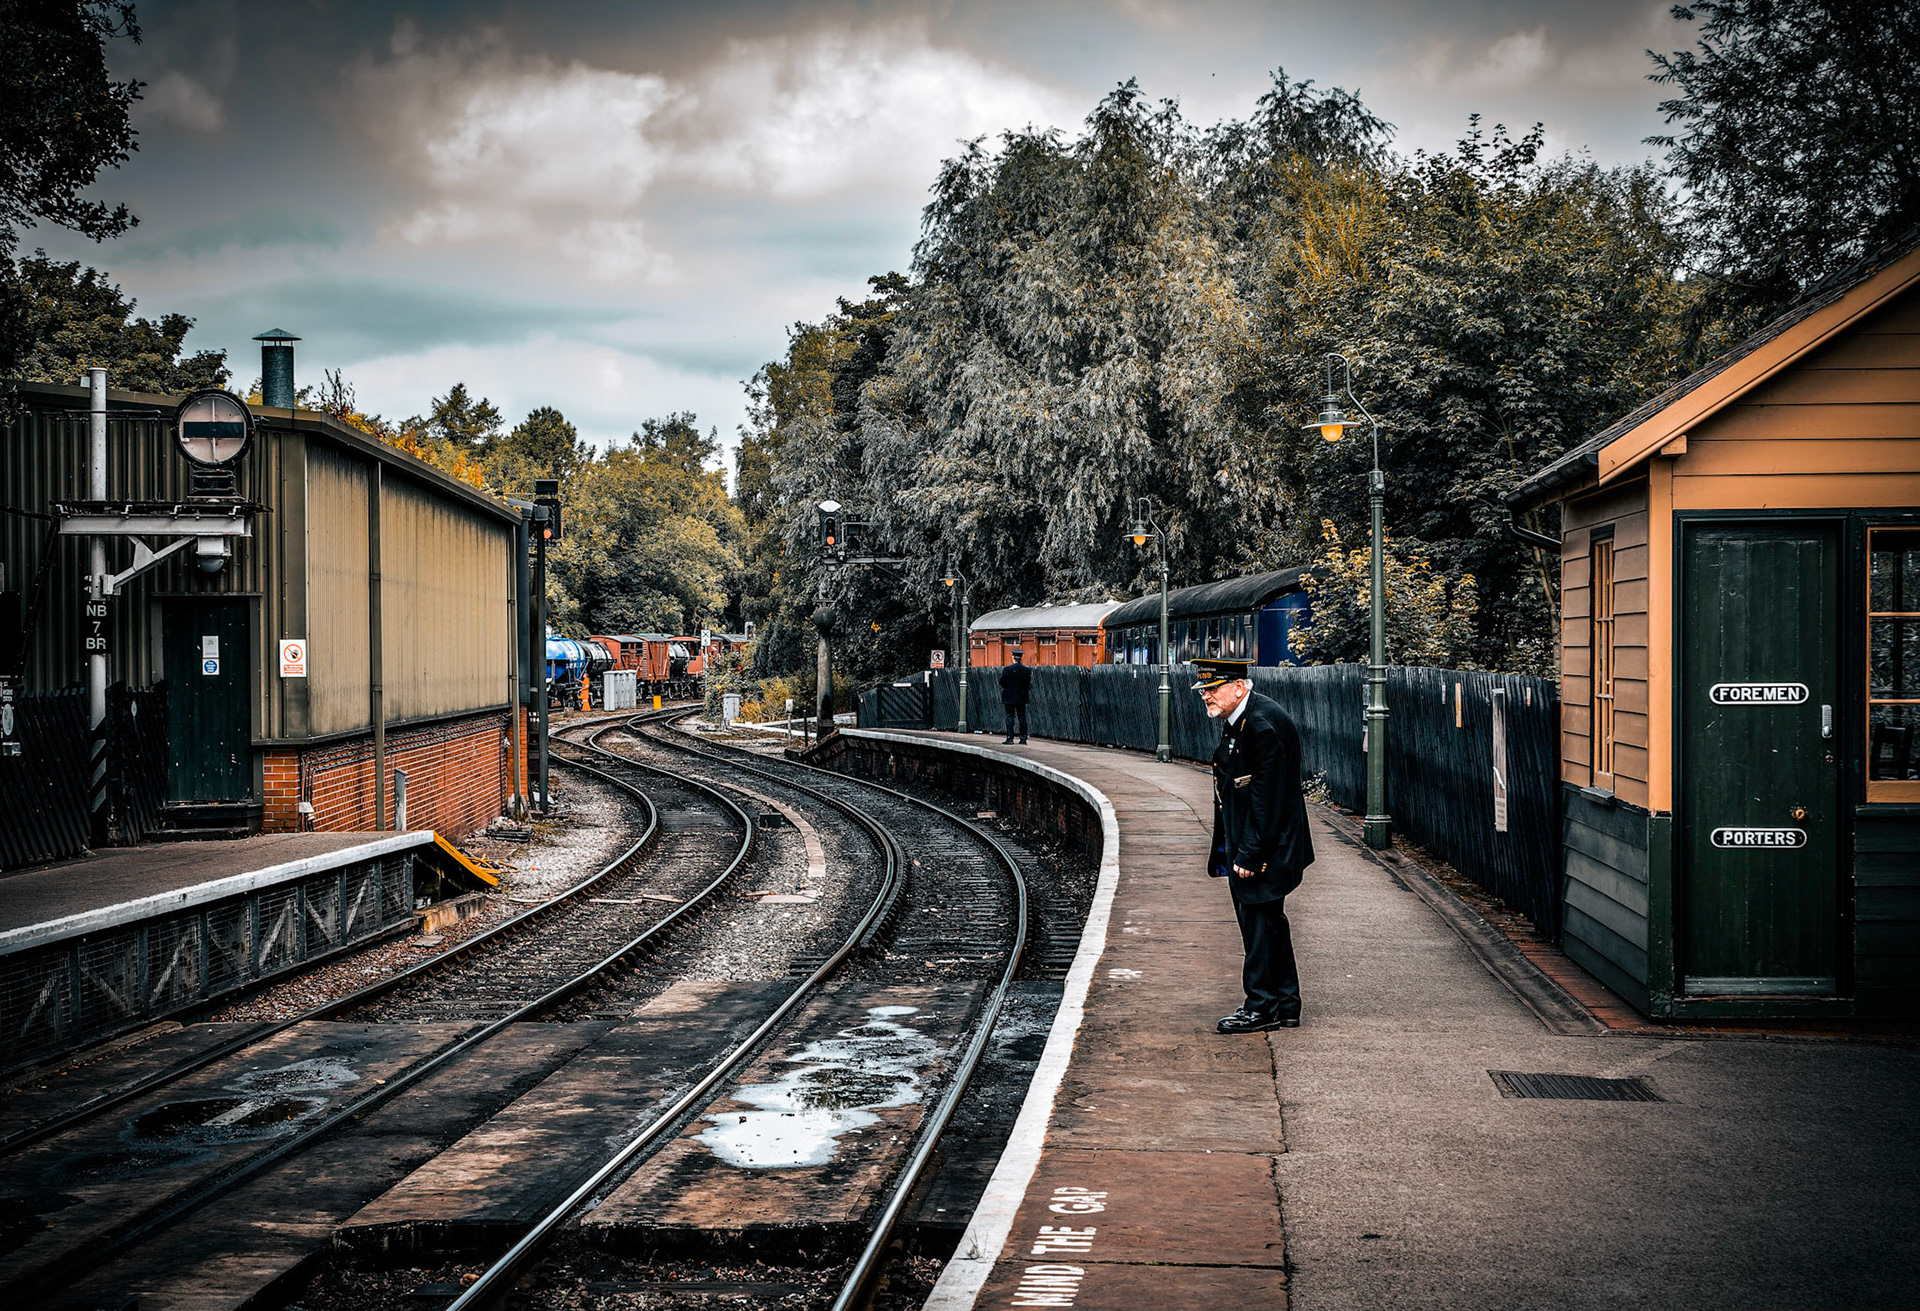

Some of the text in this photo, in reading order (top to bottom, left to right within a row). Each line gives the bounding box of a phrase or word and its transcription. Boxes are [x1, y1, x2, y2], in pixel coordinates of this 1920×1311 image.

[86, 604, 107, 617] NB
[92, 621, 101, 634] 7
[86, 637, 107, 650] BR
[1719, 686, 1801, 702] FOREMEN
[1723, 831, 1797, 846] PORTERS
[1010, 1186, 1109, 1307] MIND THE GAP
